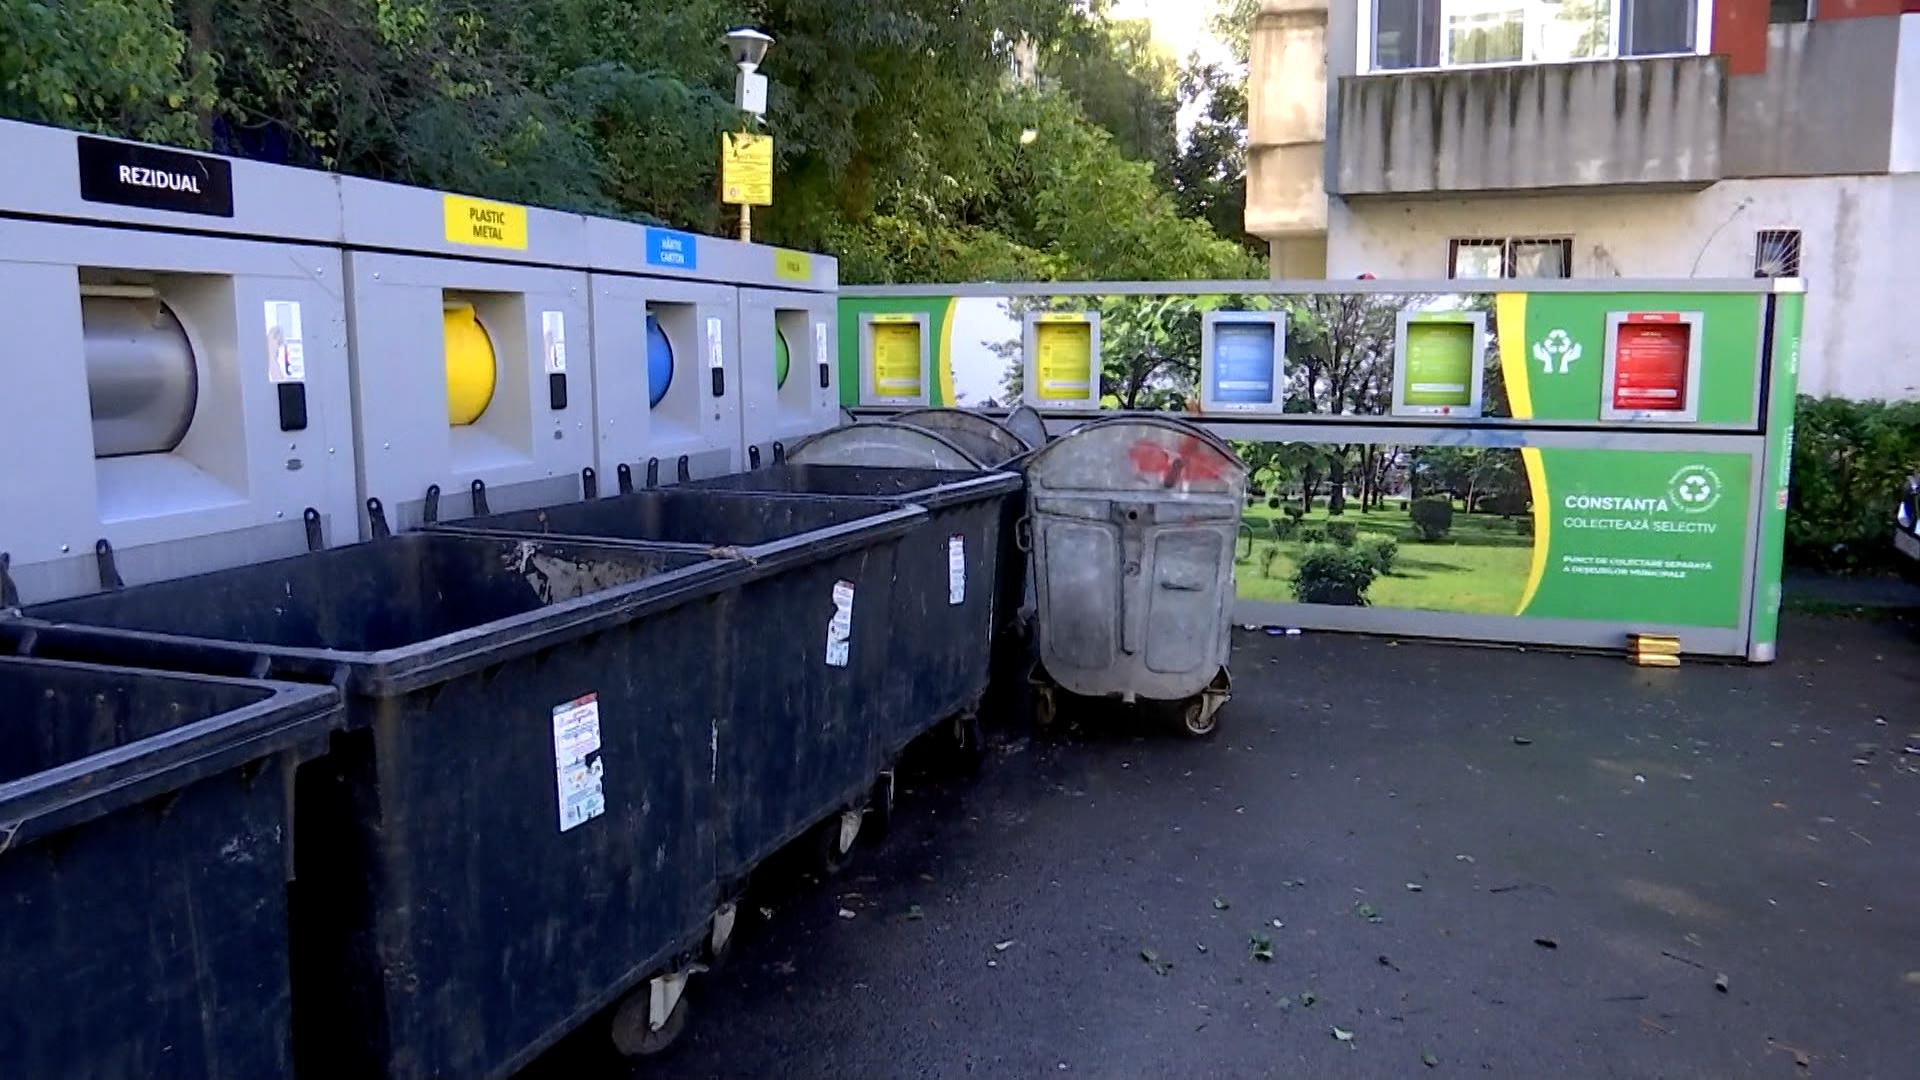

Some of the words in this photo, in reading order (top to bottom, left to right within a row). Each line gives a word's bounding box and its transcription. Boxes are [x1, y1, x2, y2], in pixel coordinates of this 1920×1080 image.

[119, 165, 201, 194] REZIDUAL
[469, 207, 505, 225] PLASTIC
[472, 225, 504, 241] METAL
[1653, 521, 1717, 533] SELECTIV
[1562, 564, 1570, 573] A
